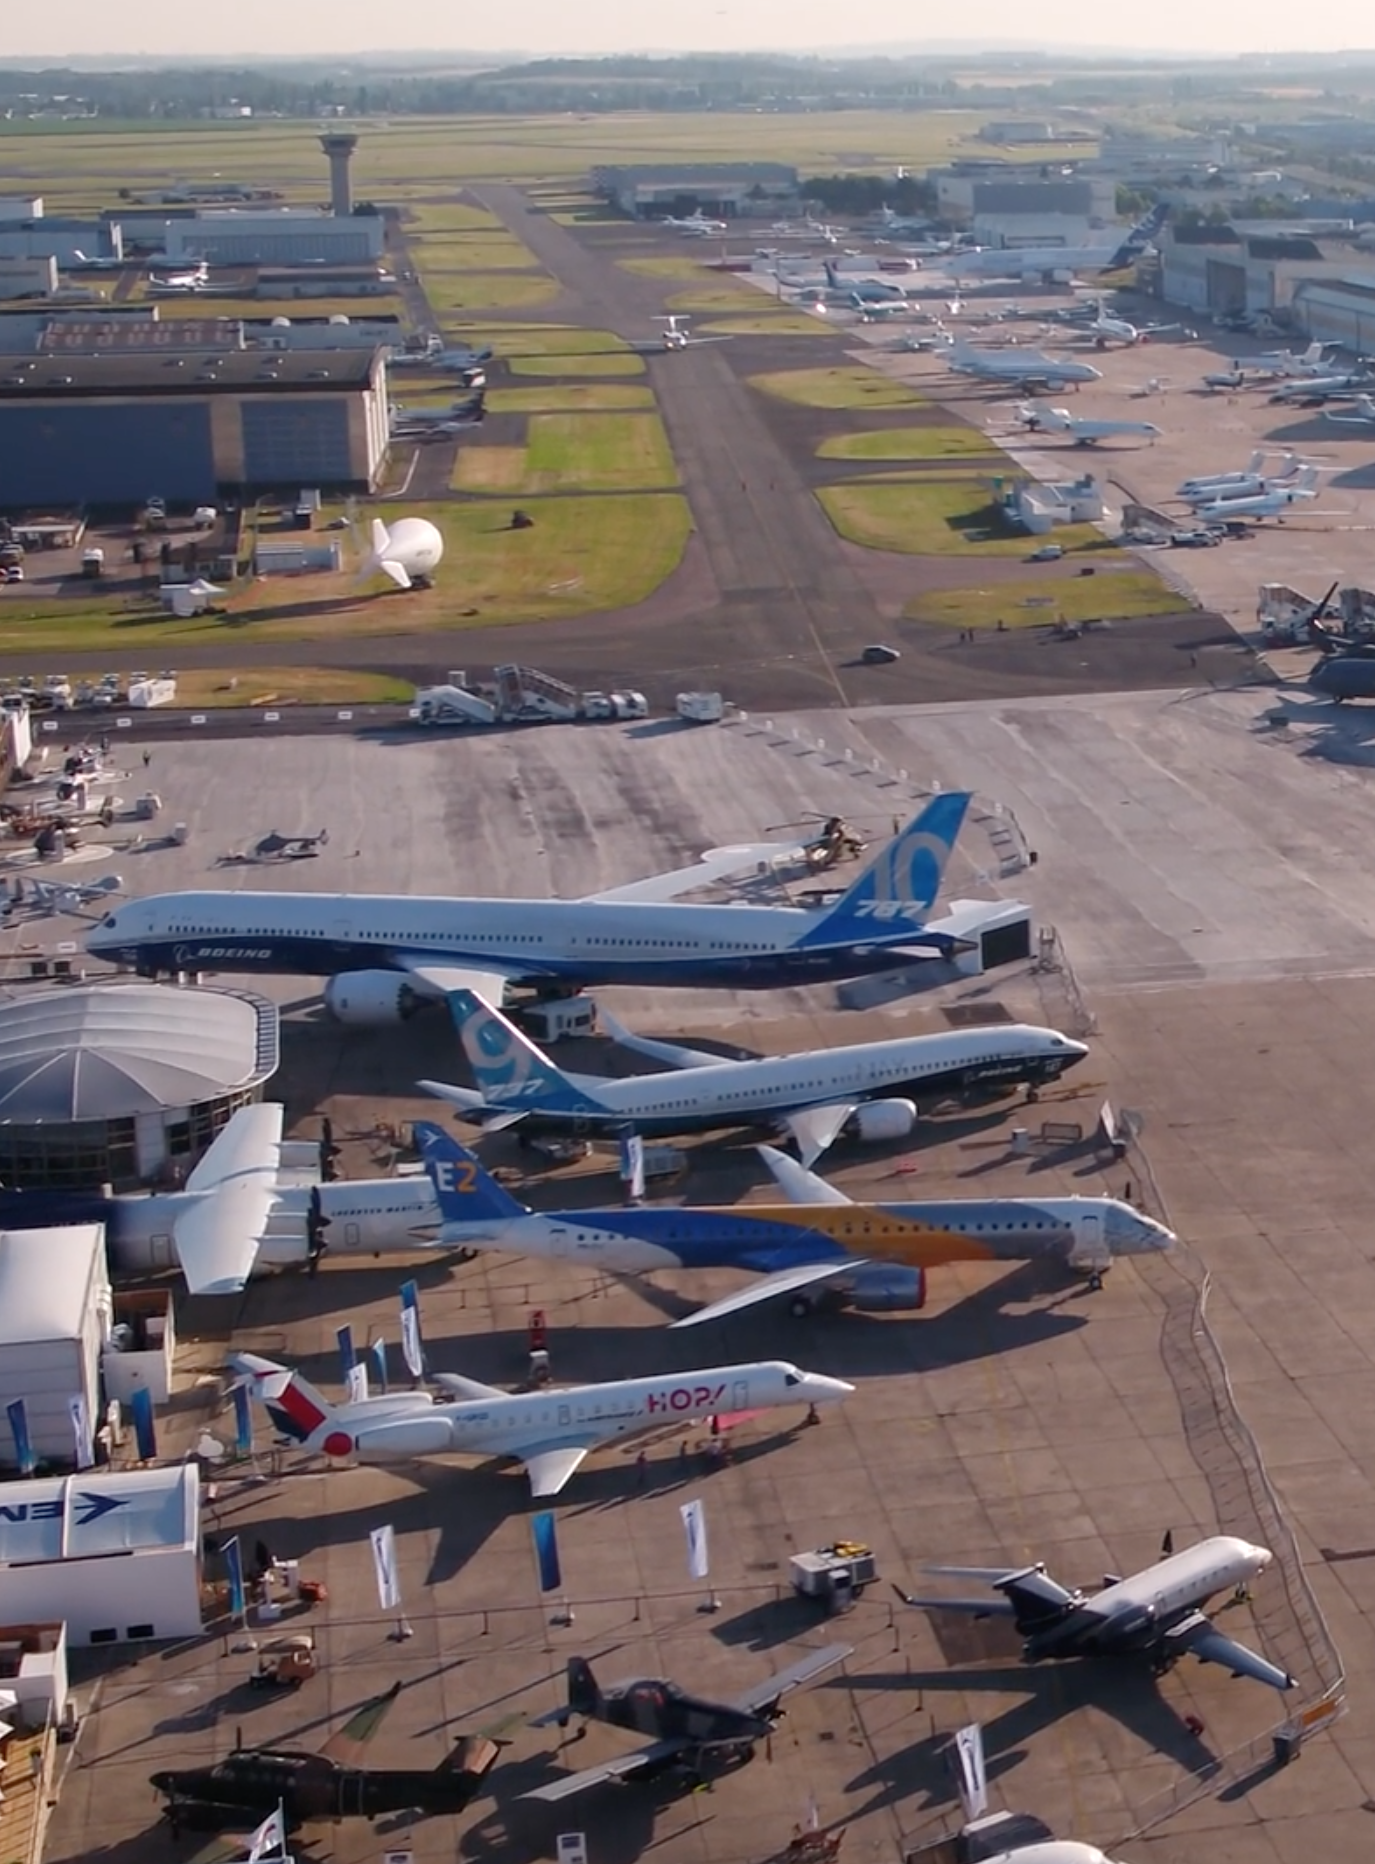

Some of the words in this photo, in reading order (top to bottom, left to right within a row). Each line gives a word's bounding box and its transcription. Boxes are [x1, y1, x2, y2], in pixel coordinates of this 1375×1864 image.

[871, 831, 950, 903] 10
[854, 900, 927, 920] 787
[197, 947, 272, 960] BOEING
[436, 1161, 477, 1194] E2
[648, 1384, 726, 1413] HOP!
